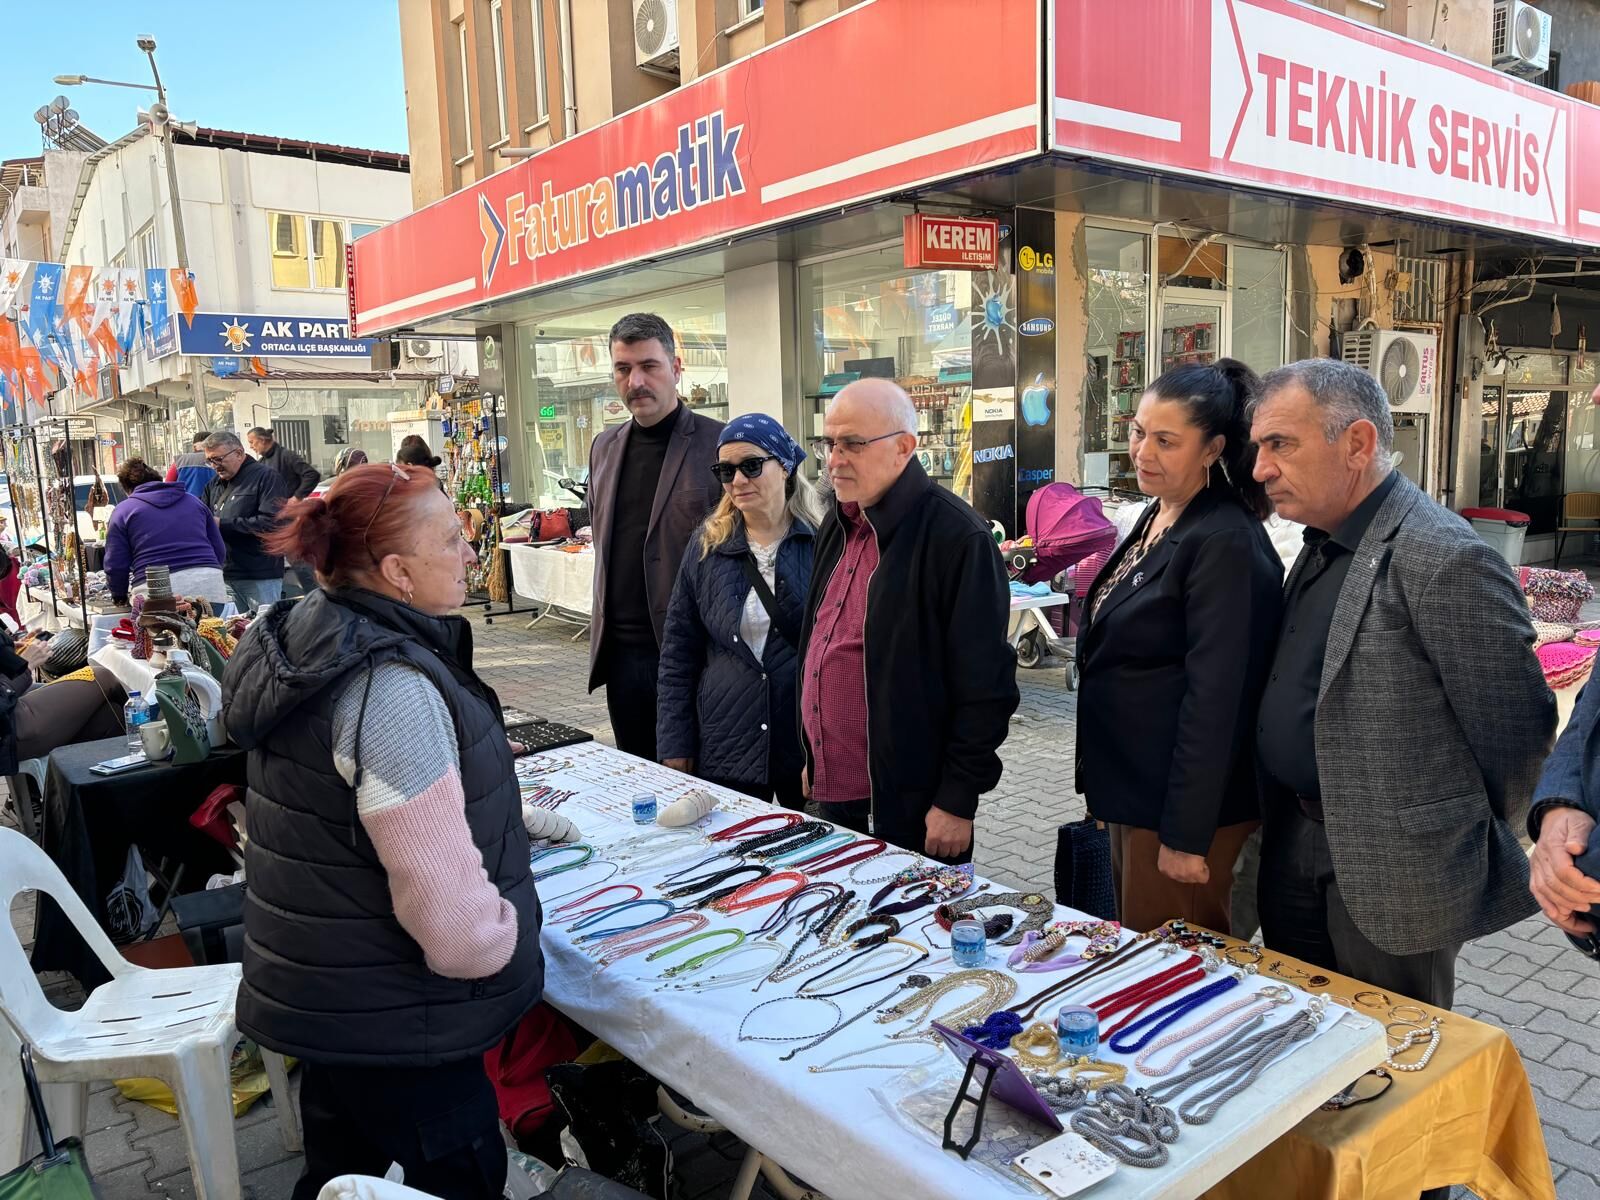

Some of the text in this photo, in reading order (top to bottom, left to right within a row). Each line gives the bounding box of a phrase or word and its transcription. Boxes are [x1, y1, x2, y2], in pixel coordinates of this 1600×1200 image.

[1257, 52, 1540, 196] TEKNİK SERVİS
[506, 109, 746, 266] Faturamatik
[926, 224, 992, 251] KEREM
[260, 321, 349, 339] AK PART
[1022, 322, 1053, 333] SAMSUNG
[261, 343, 296, 352] ORTACA
[317, 343, 367, 354] BAŞKANLIĞI
[1420, 347, 1429, 384] ALTUS
[973, 444, 1014, 464] NOKIA
[1018, 468, 1053, 484] Casper
